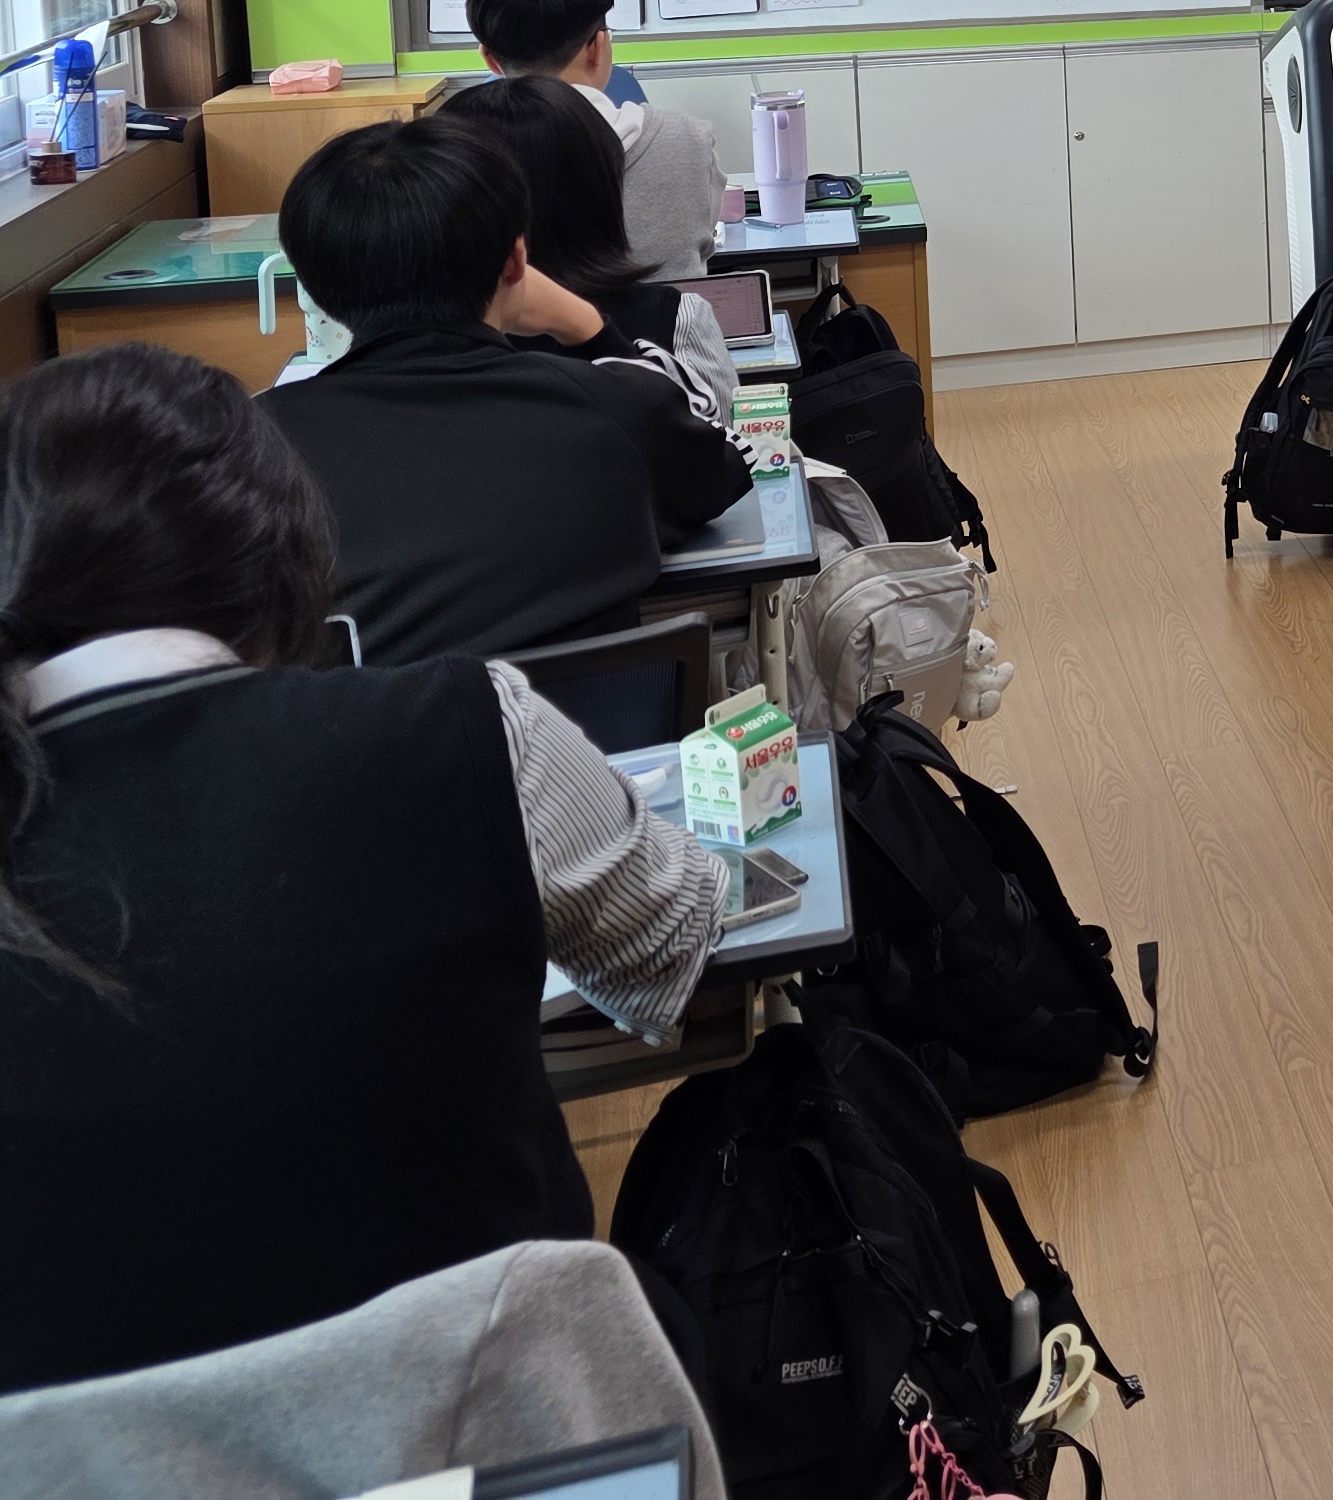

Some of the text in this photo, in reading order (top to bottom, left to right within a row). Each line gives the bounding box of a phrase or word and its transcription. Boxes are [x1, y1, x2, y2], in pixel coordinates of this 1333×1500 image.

[739, 420, 786, 434] 서울우유
[743, 711, 778, 733] 서울우유
[743, 736, 794, 772] 서울우유
